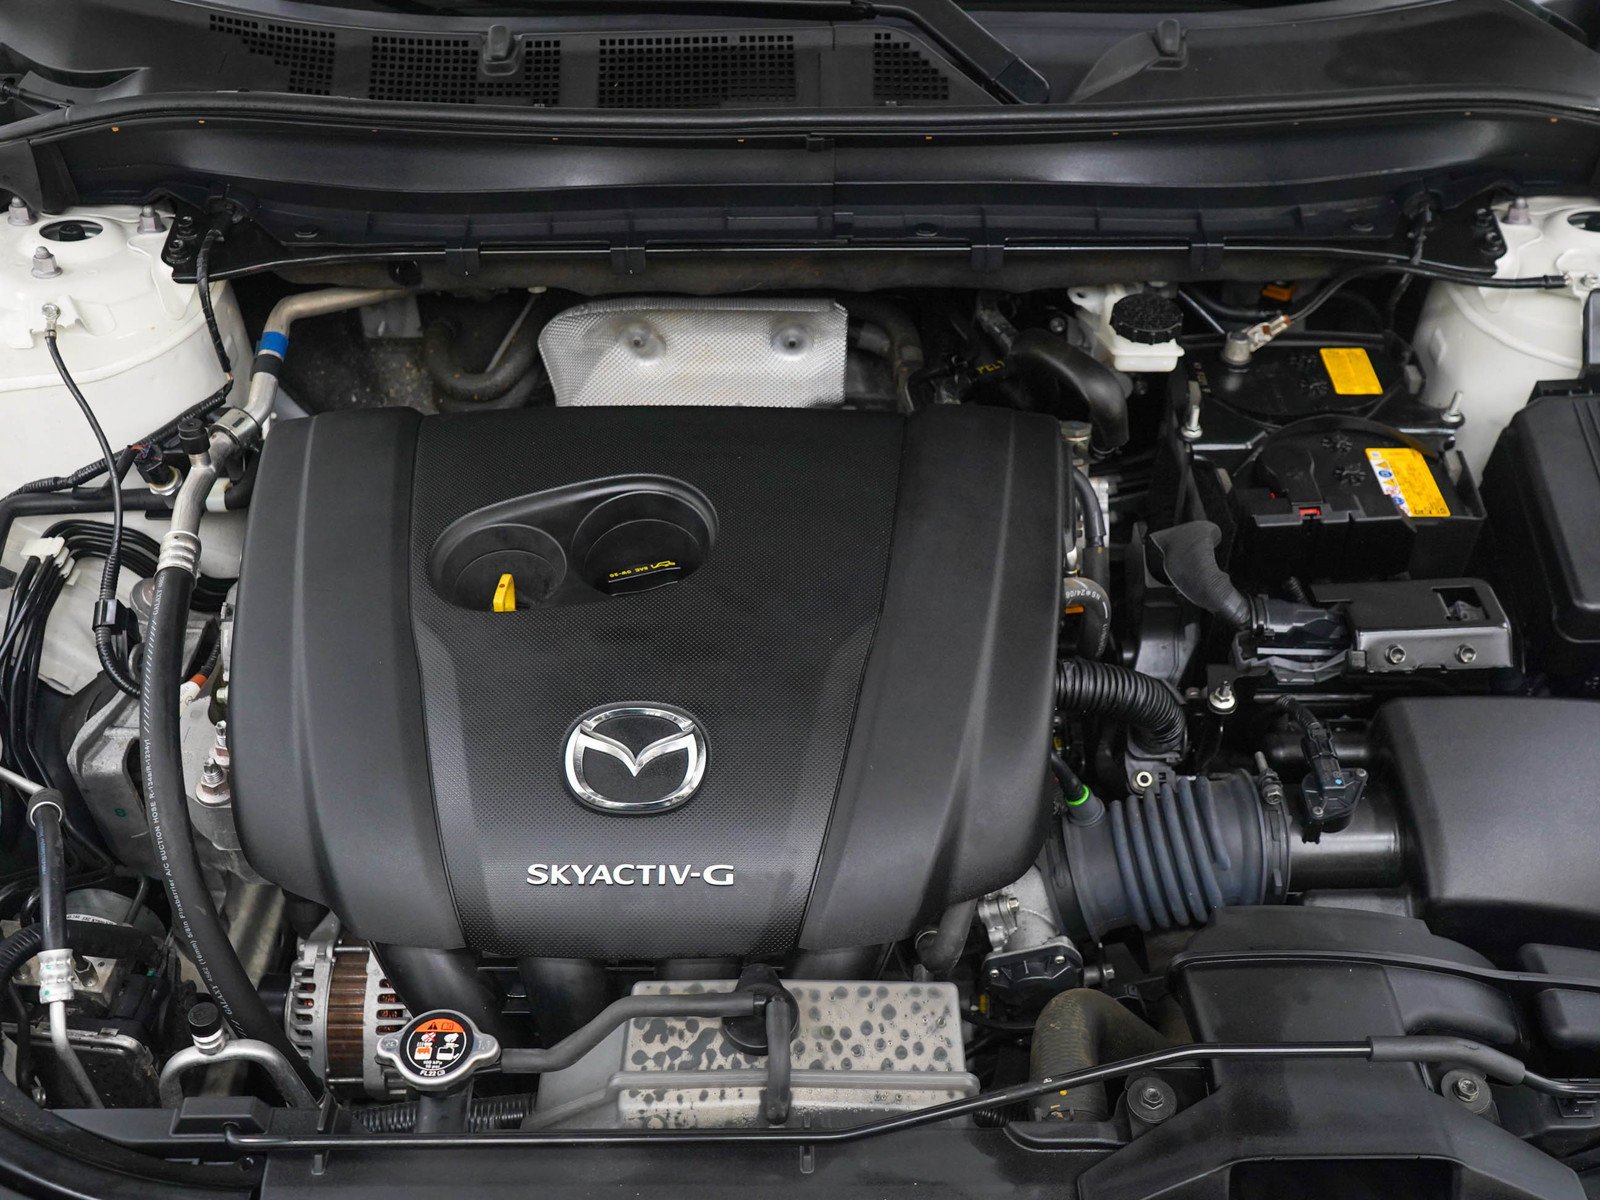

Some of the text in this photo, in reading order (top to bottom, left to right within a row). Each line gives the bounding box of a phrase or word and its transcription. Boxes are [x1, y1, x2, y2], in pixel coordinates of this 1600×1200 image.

[609, 569, 632, 578] 0W-20
[152, 588, 163, 616] GALAXY
[150, 800, 159, 824] HOSE
[154, 825, 168, 861] SUCTION
[163, 863, 172, 877] A/C
[526, 863, 735, 887] SKYACTIV-G
[212, 985, 233, 1016] GALAXY
